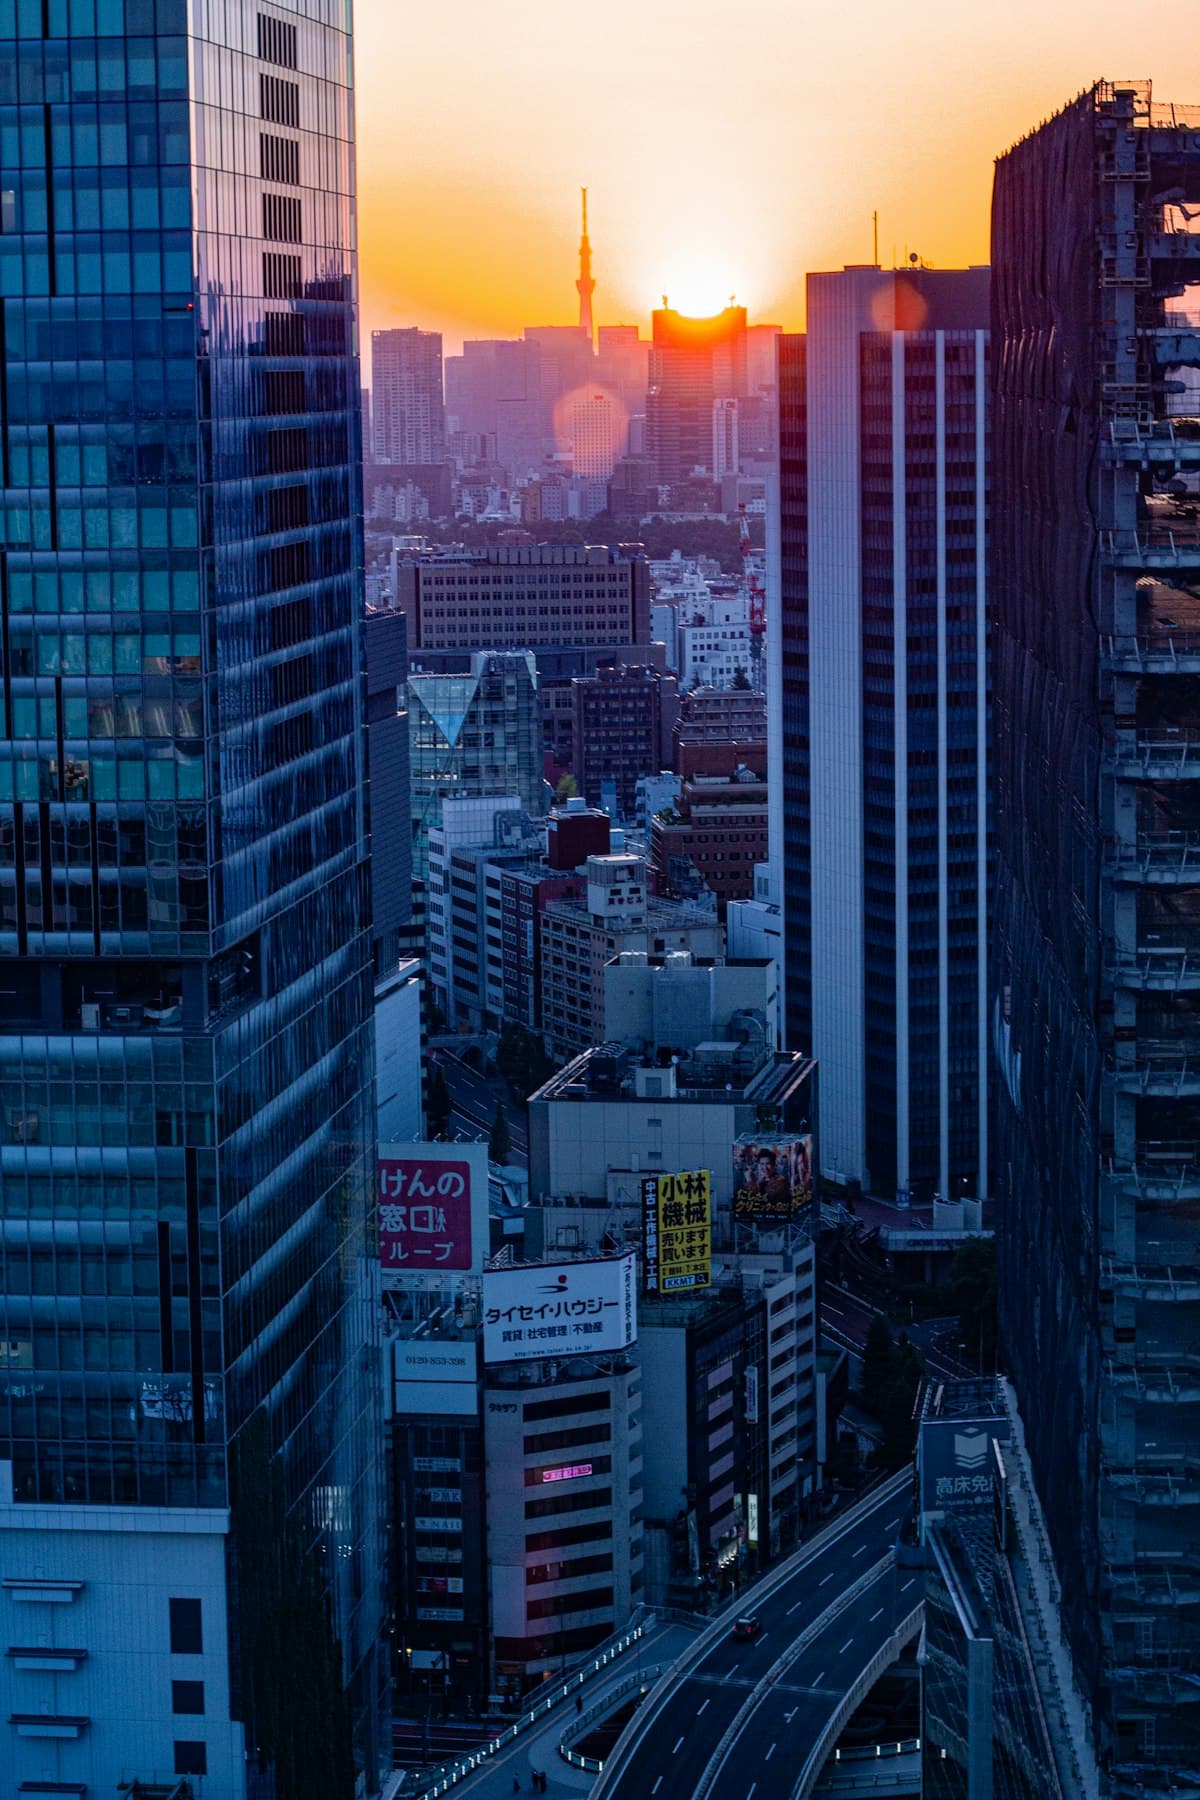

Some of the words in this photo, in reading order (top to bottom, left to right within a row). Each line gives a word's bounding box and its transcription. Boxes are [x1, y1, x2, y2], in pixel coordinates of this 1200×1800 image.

[381, 1168, 465, 1197] けんの
[662, 1173, 706, 1201] 小林
[380, 1204, 434, 1233] 窓口
[662, 1199, 707, 1229] 機械
[662, 1229, 708, 1247] 売ります
[381, 1240, 455, 1261] ループ
[662, 1244, 708, 1262] 買います
[667, 1276, 694, 1287] KKMT
[486, 1297, 619, 1324] タイセイ・ハウジー
[502, 1329, 523, 1343] 賃貸
[527, 1325, 568, 1339] 社宅管理
[572, 1321, 603, 1335] 不動産
